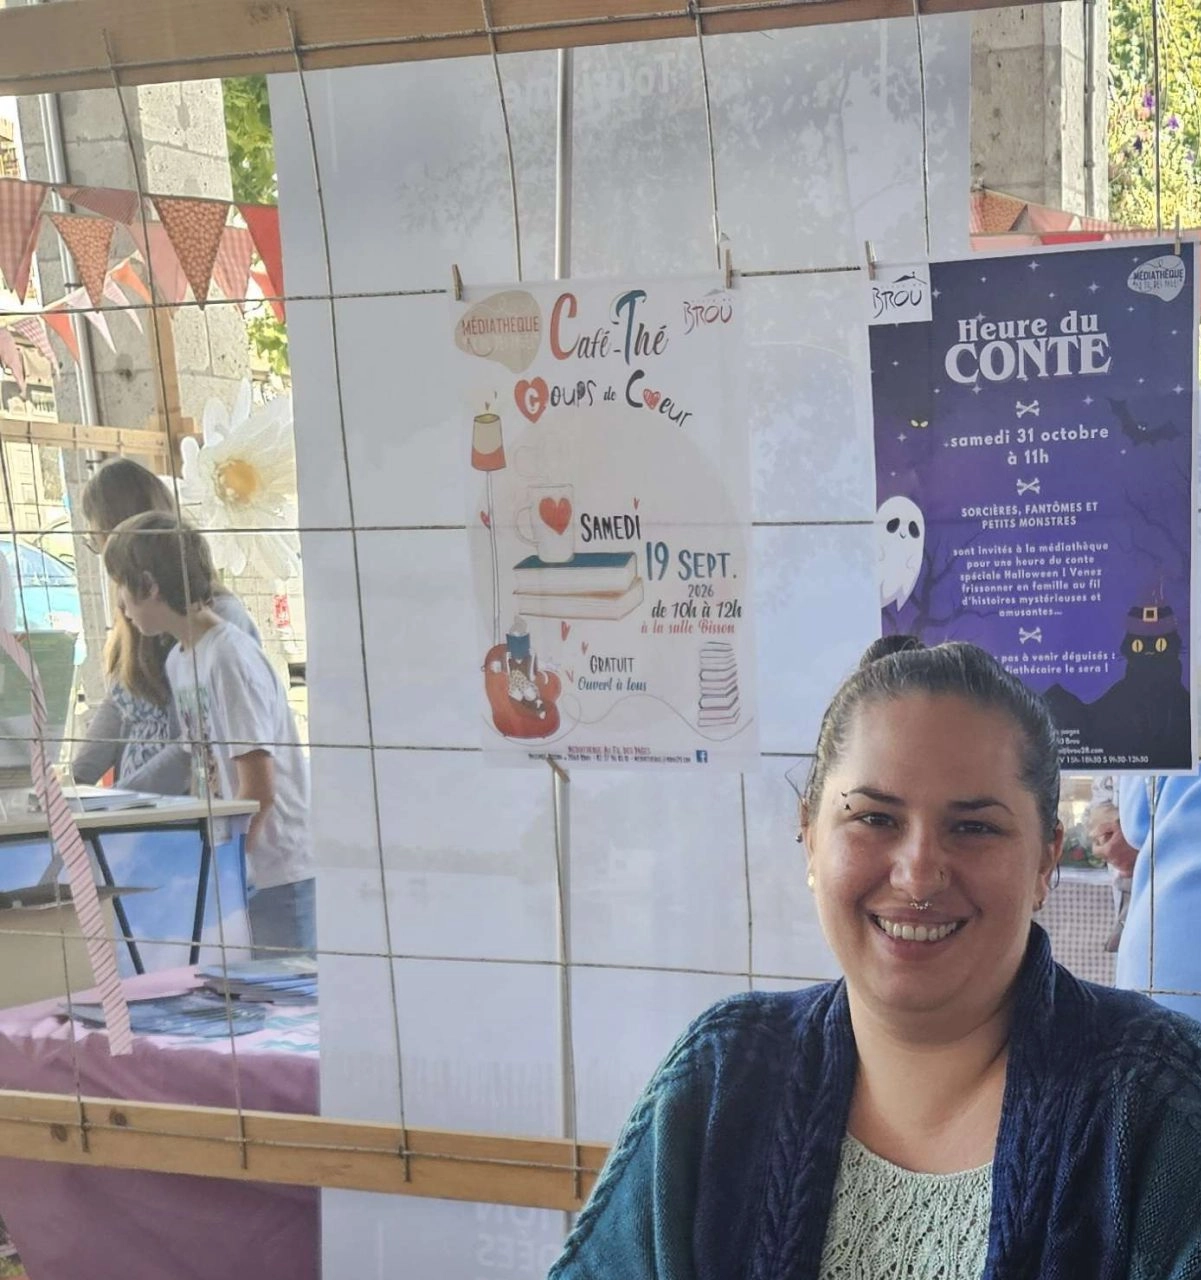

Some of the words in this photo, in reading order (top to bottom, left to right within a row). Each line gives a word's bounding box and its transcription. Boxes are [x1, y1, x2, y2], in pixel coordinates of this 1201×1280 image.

[958, 317, 1047, 343] Heure
[1060, 310, 1099, 333] du
[945, 333, 1112, 384] CONTE
[604, 386, 616, 401] de
[951, 430, 1010, 448] samedi
[1017, 428, 1034, 443] 31
[1041, 425, 1109, 442] octobre
[1008, 451, 1017, 465] à
[1024, 449, 1049, 464] 11h
[961, 503, 1021, 517] SORCIÈRES,
[1025, 501, 1082, 514] FANTÔMES
[1086, 501, 1098, 512] ET
[581, 514, 641, 542] SAMEDI
[982, 519, 1016, 529] PETITS
[1019, 516, 1077, 528] MONSTRES
[953, 547, 975, 557] sont
[978, 545, 1012, 555] invités
[1016, 543, 1023, 554] à
[1025, 543, 1036, 553] la
[1039, 541, 1109, 555] médiathèque
[646, 542, 669, 581] 19
[967, 560, 990, 570] pour
[994, 559, 1012, 568] une
[1016, 556, 1045, 566] heure
[1049, 555, 1062, 565] du
[1066, 555, 1094, 564] conte
[960, 570, 1000, 582] spéciale
[1004, 569, 1058, 579] Halloween
[1070, 567, 1102, 577] Venez
[688, 584, 714, 598] 2026
[962, 583, 1013, 594] frissonner
[1017, 582, 1029, 591] en
[1032, 581, 1068, 591] famille
[1073, 581, 1086, 590] au
[1089, 579, 1100, 589] fil
[962, 595, 1016, 606] d'histoires
[1019, 593, 1087, 606] mystérieuses
[1091, 593, 1101, 602] et
[652, 605, 666, 618] de
[672, 601, 697, 618] 10h
[702, 601, 710, 617] à
[718, 601, 742, 618] 12h
[641, 621, 648, 634] à
[653, 622, 664, 634] la
[669, 621, 693, 634] salle
[698, 621, 735, 634] Bisson
[590, 656, 635, 673] GRATUIT
[1001, 655, 1018, 664] pas
[1023, 652, 1028, 662] à
[1032, 652, 1058, 661] venir
[1062, 651, 1108, 662] déguisés
[1005, 664, 1062, 674] iathécaire
[1065, 663, 1074, 673] le
[1079, 665, 1101, 673] sera
[578, 677, 612, 691] Ouvert
[616, 677, 623, 691] à
